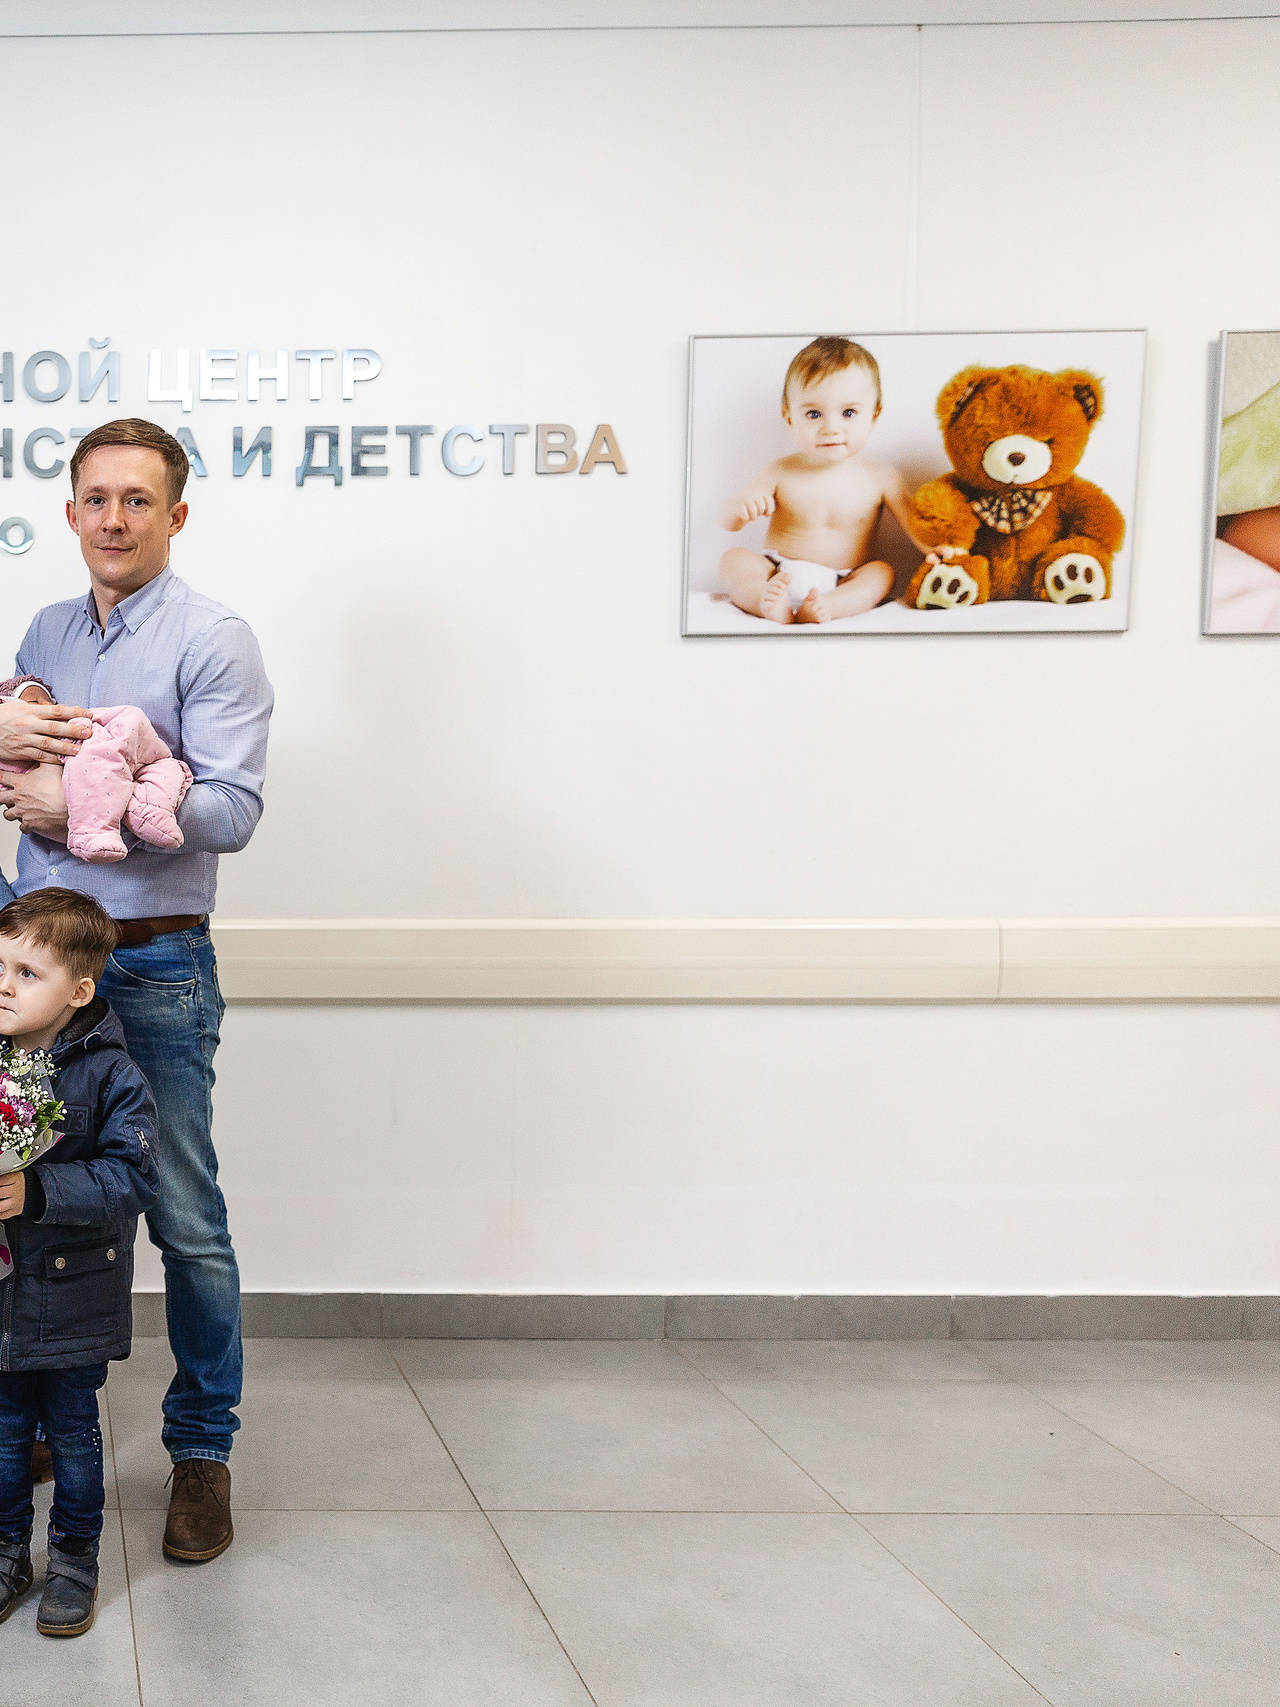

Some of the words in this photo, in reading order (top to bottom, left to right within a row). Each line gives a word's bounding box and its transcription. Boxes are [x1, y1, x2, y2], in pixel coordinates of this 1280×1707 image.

[147, 348, 383, 413] ЦЕНТР
[232, 426, 273, 478] И
[295, 423, 628, 488] ДЕТСТВА
